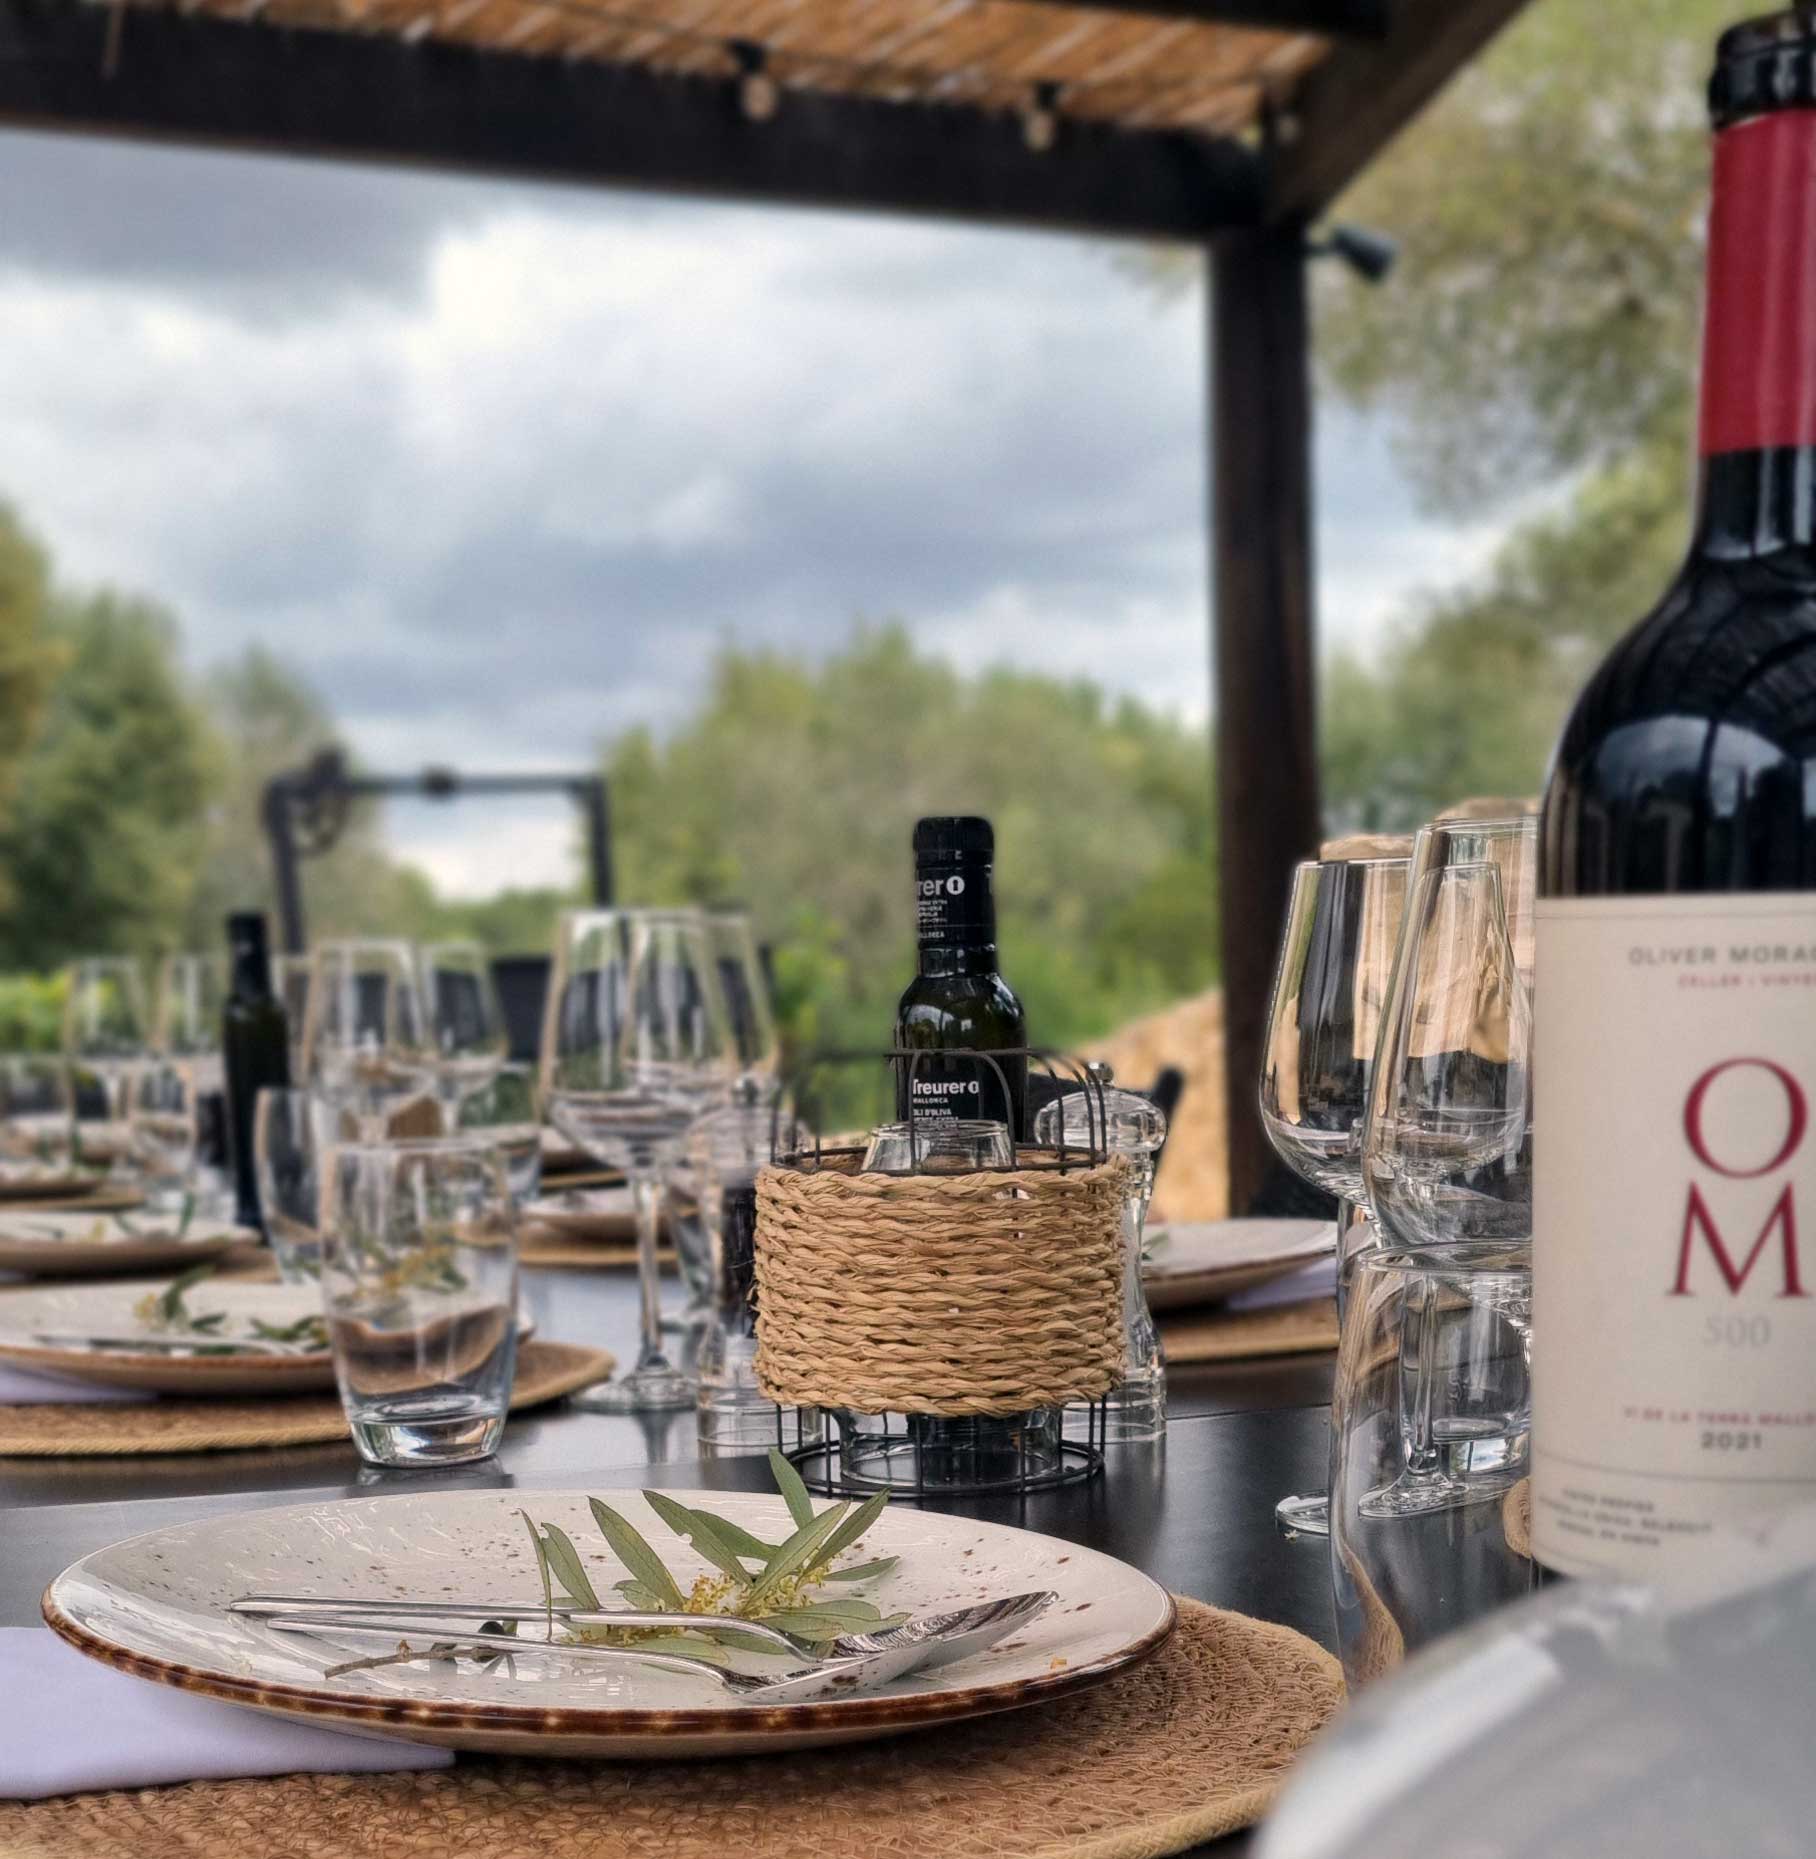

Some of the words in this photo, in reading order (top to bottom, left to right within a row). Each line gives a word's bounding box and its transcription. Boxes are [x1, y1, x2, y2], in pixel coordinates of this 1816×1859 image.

[1628, 946, 1717, 966] OLIVER
[1683, 1057, 1808, 1179] O
[1666, 1180, 1812, 1298] M
[1703, 1315, 1771, 1348] 500
[1701, 1431, 1762, 1450] 2021
